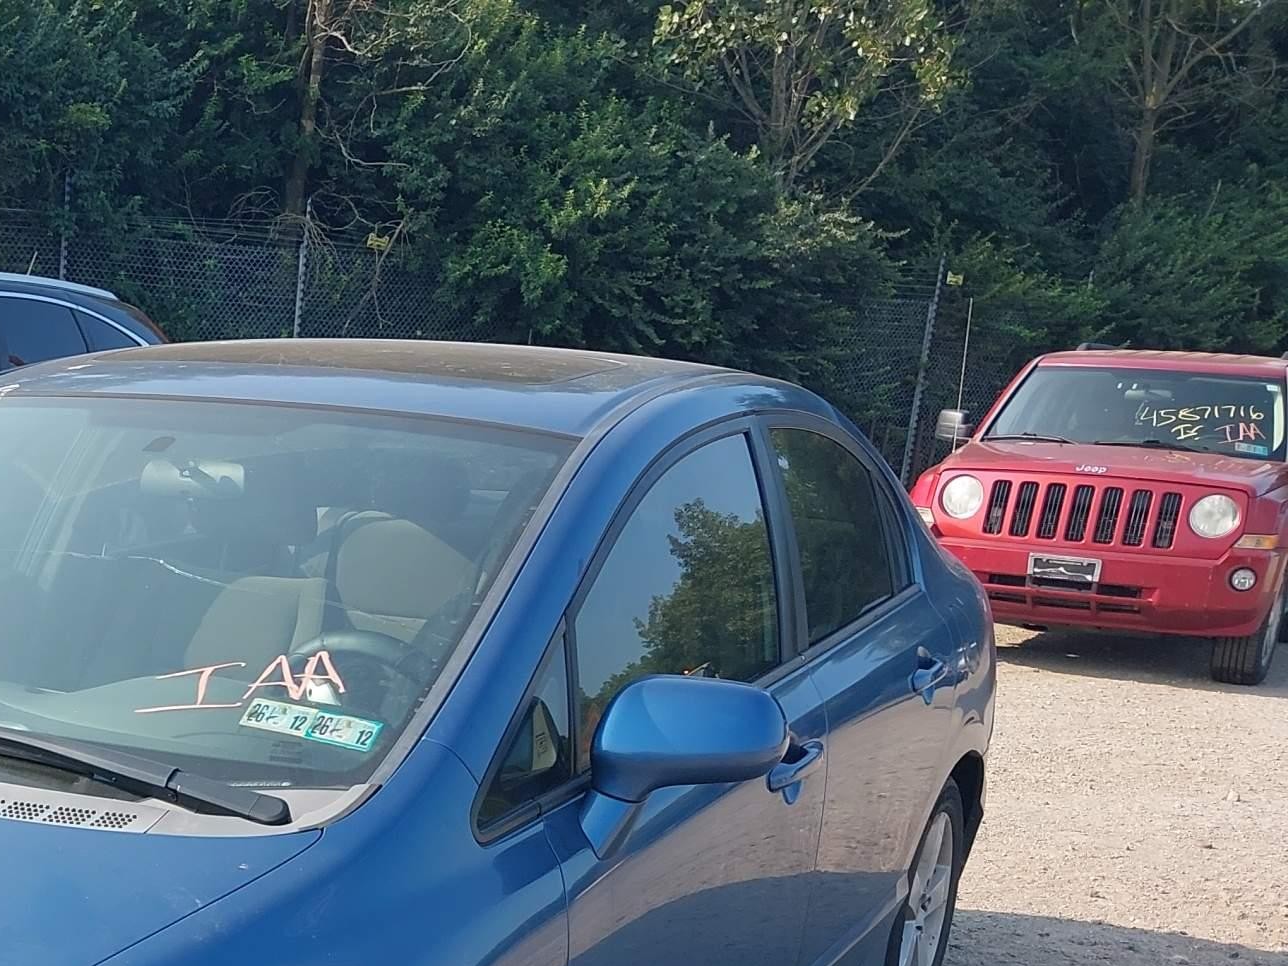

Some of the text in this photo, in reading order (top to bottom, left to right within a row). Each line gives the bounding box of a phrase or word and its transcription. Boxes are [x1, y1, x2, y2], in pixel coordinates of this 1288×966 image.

[1075, 464, 1107, 474] Jeep
[134, 650, 347, 713] IAA
[289, 715, 307, 731] 12
[310, 715, 373, 746] 26 12
